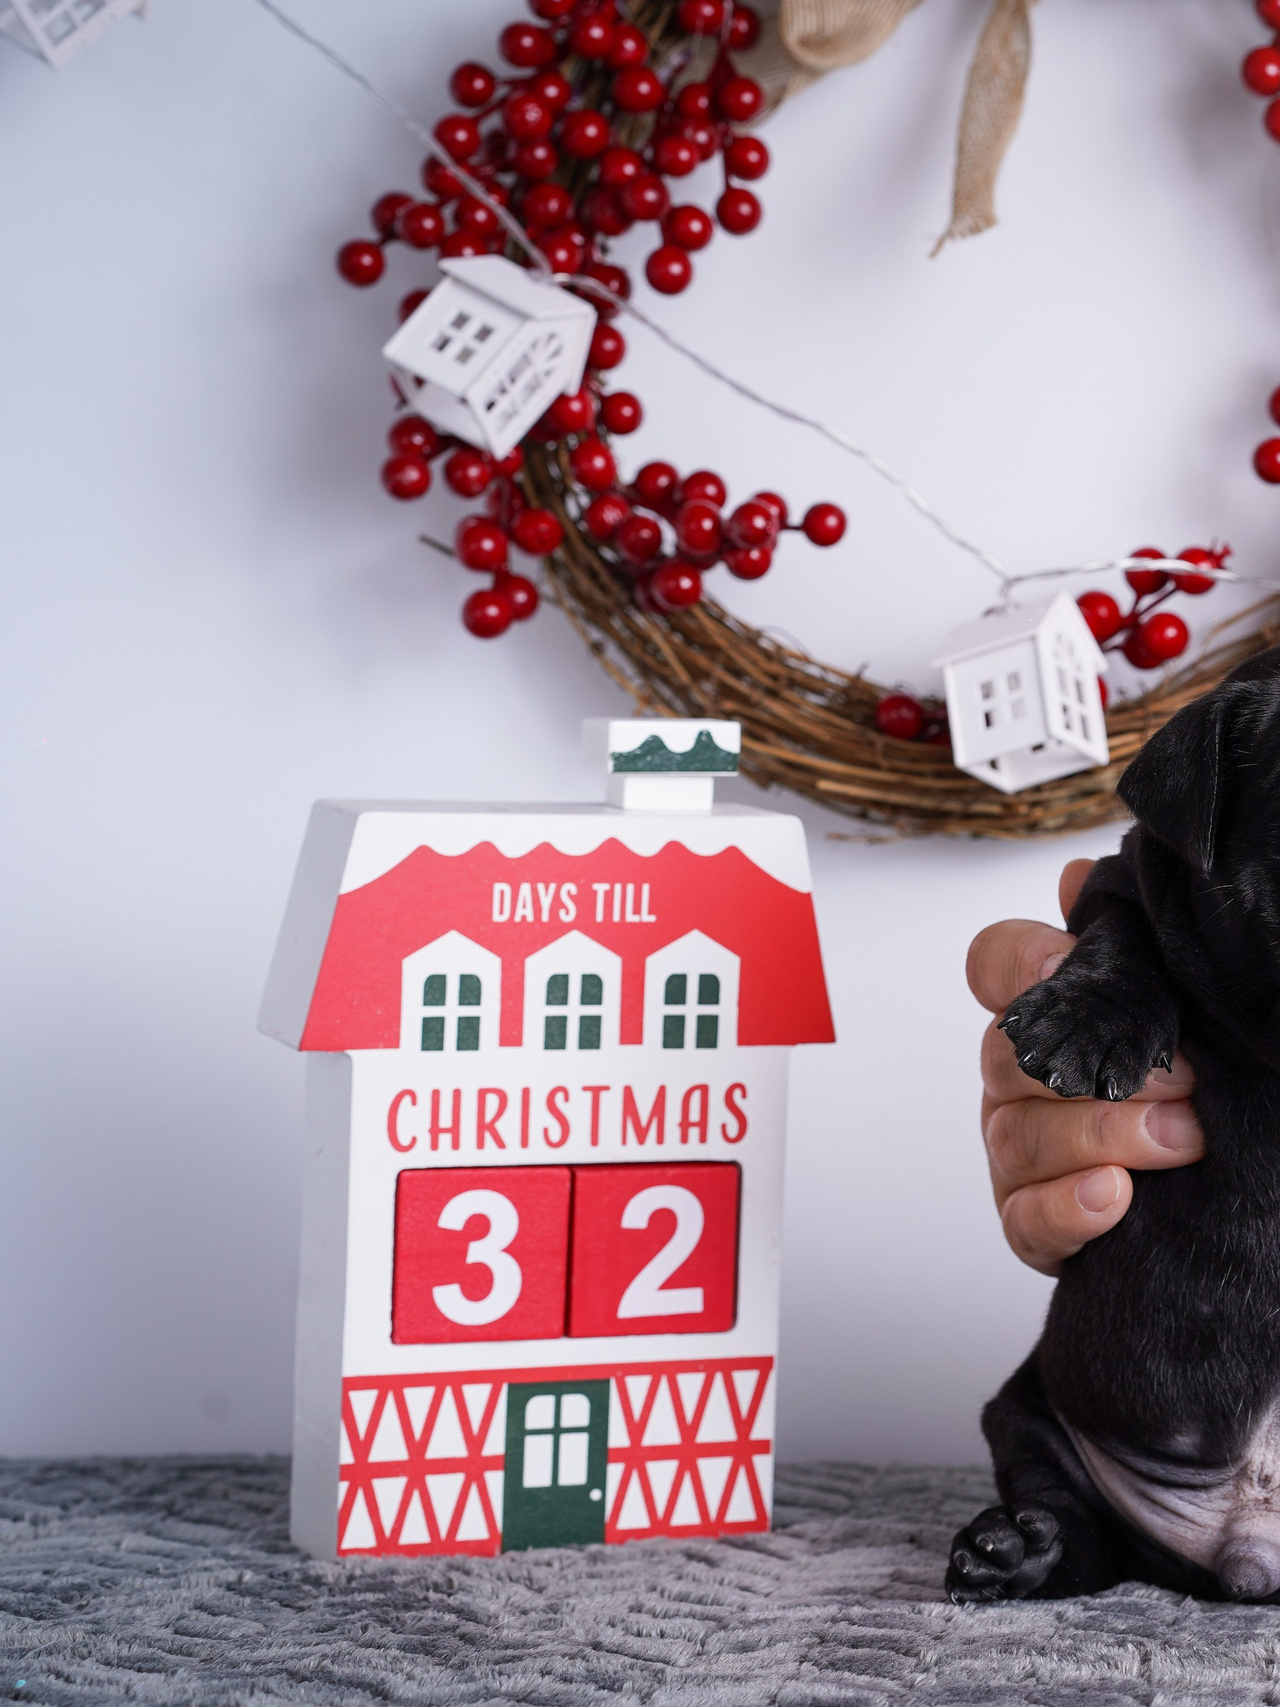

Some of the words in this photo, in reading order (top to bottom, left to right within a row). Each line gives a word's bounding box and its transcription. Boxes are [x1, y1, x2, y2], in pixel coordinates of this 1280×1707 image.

[492, 882, 578, 923] DAYS
[591, 882, 657, 923] TILL
[387, 1081, 749, 1153] CHRISTMAS
